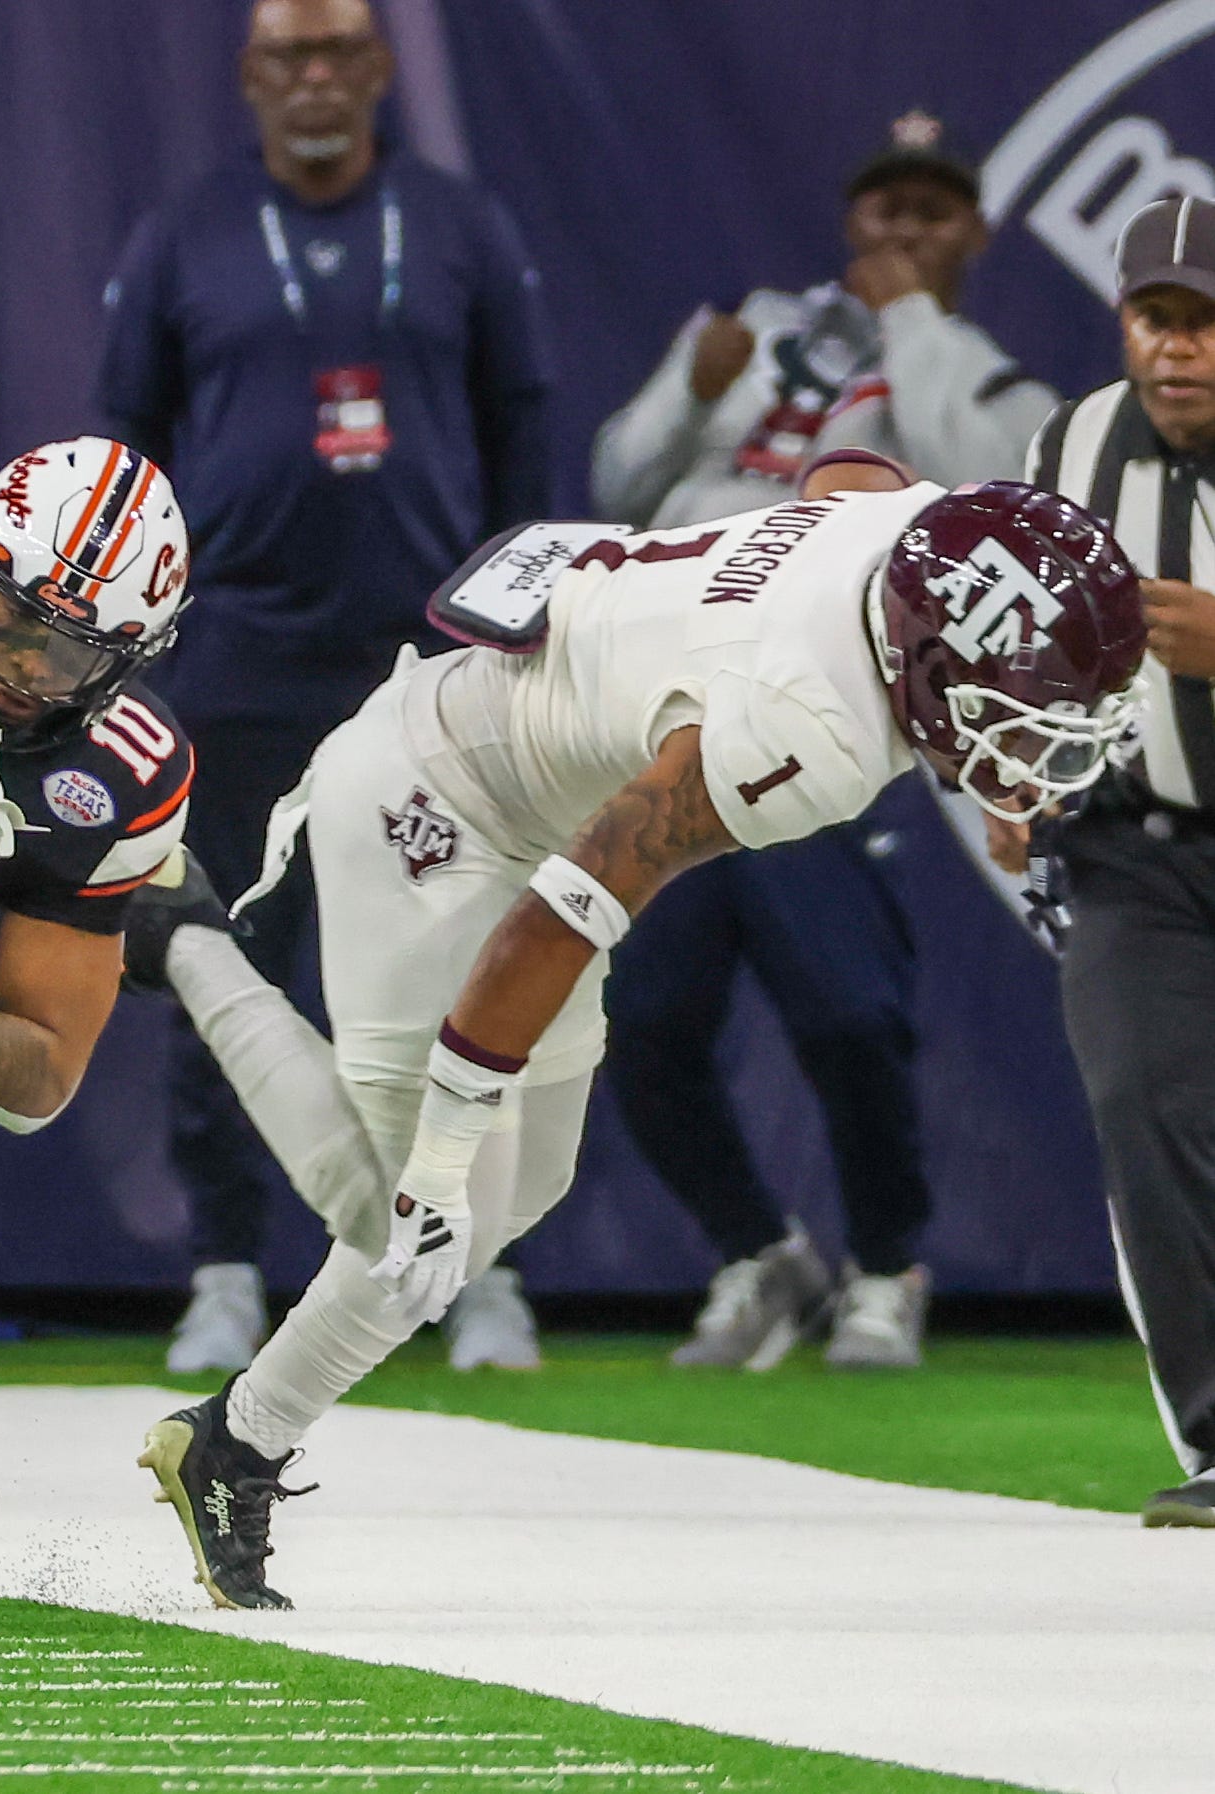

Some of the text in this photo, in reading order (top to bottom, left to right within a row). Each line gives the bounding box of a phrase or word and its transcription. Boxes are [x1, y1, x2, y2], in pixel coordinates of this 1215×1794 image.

[701, 494, 844, 604] NDERSON
[90, 693, 177, 786] 10
[55, 777, 107, 819] TEXAS
[736, 753, 803, 806] 1
